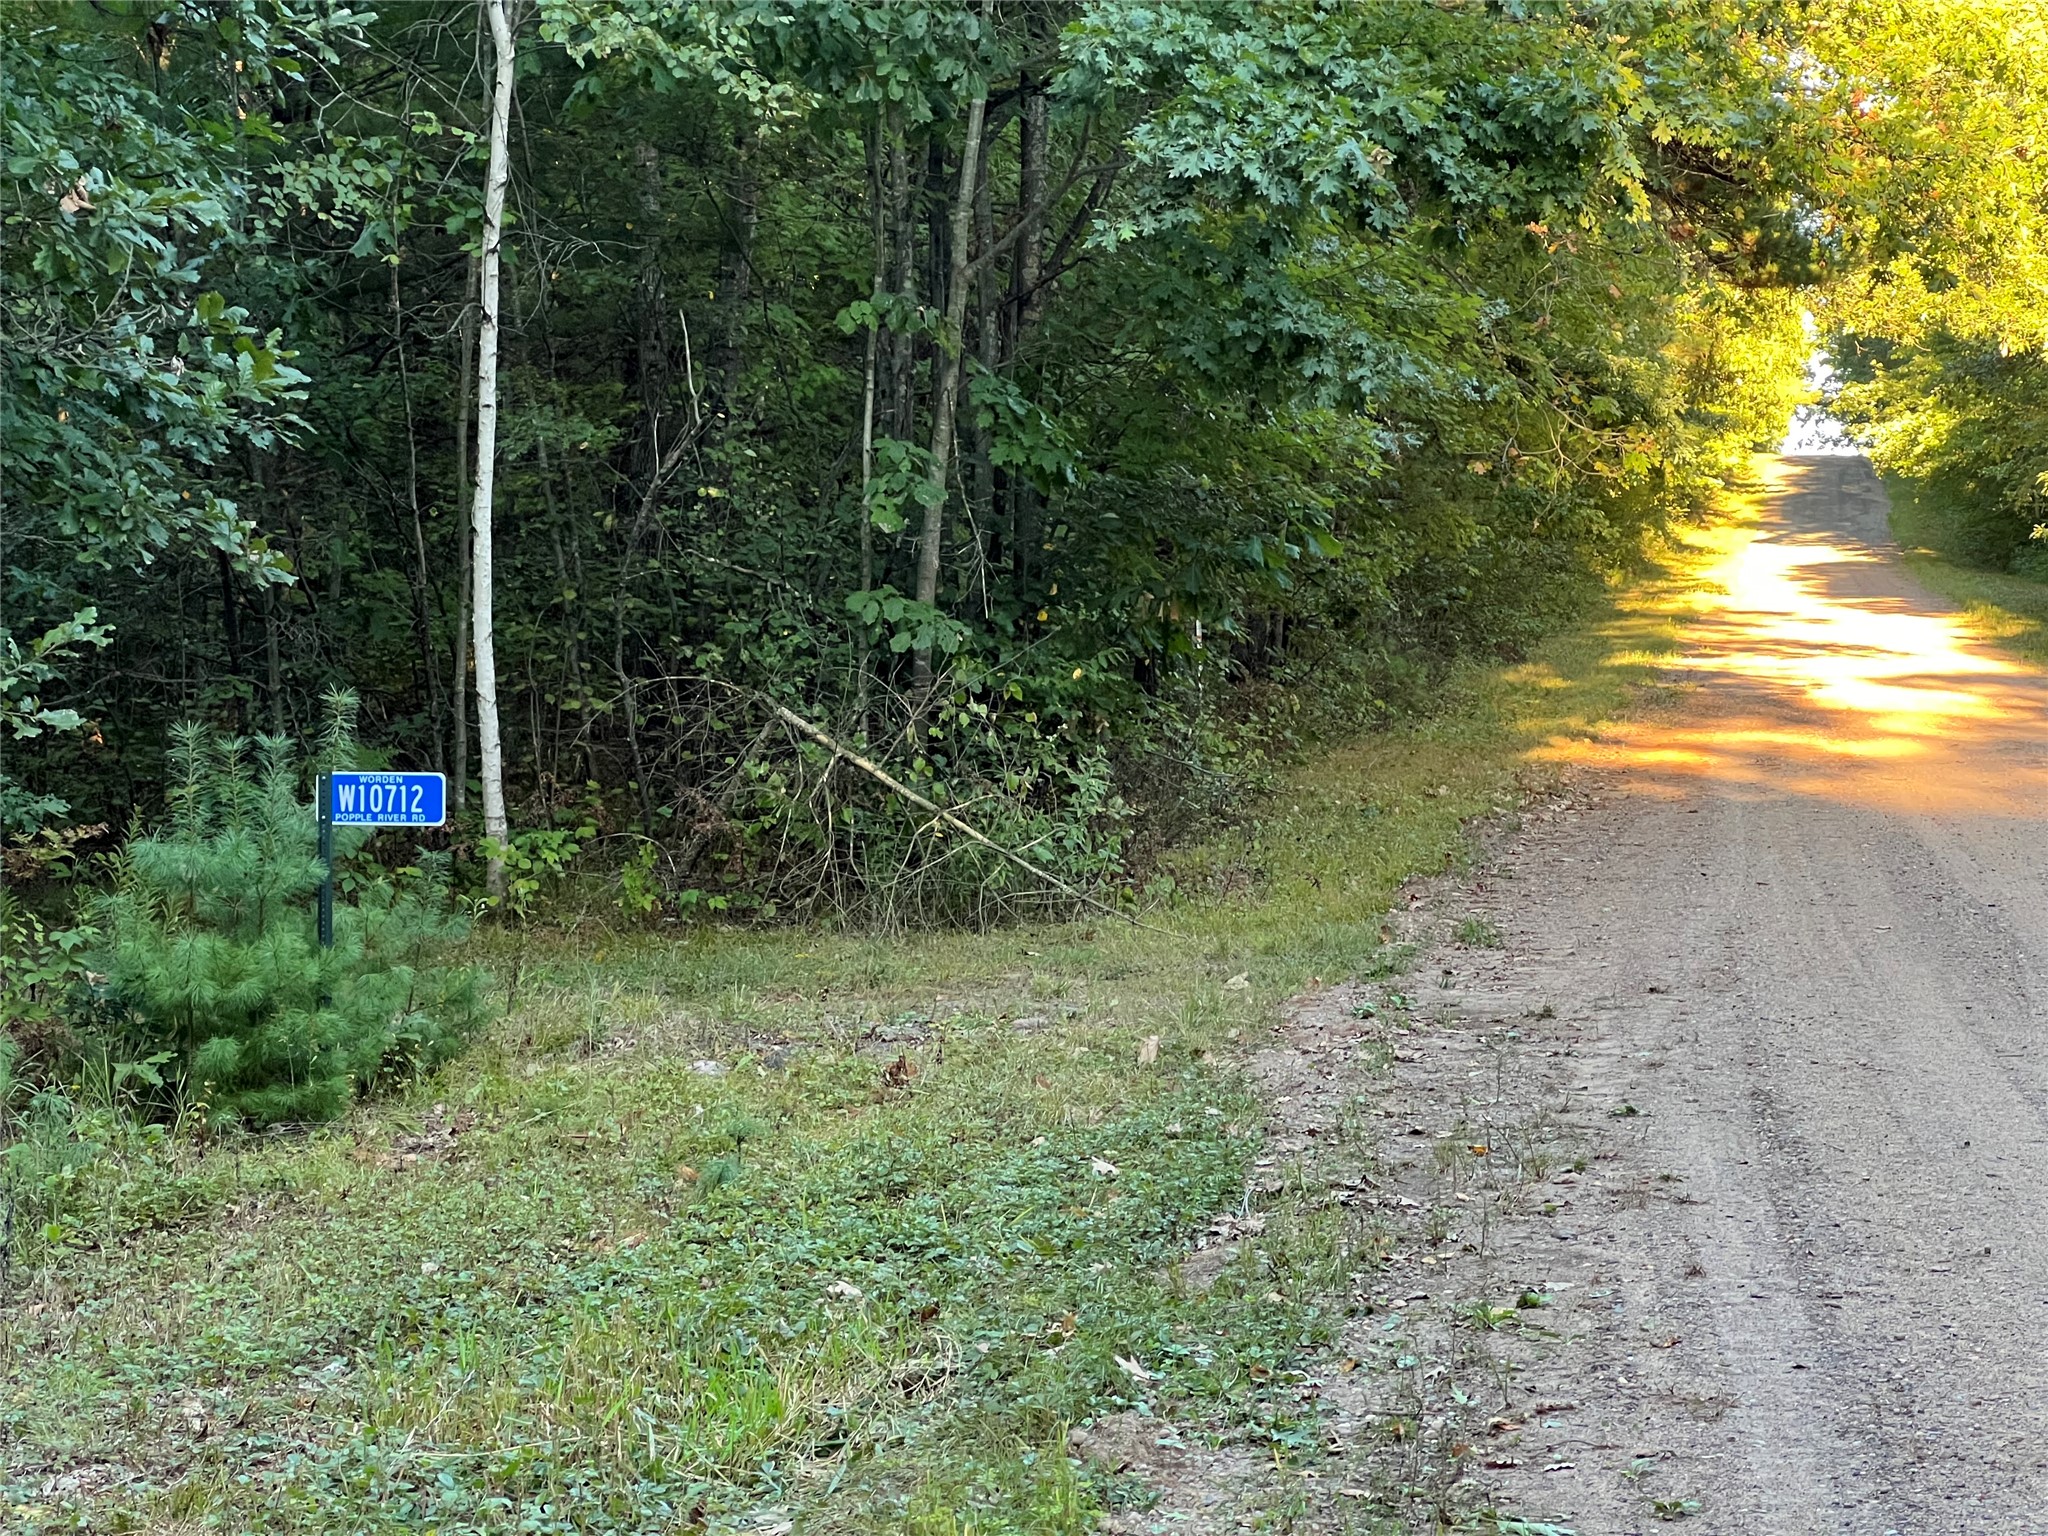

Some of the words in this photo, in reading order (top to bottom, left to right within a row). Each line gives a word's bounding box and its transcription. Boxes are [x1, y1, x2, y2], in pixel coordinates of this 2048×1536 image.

[359, 776, 403, 784] WORDEN
[338, 784, 424, 813] W10712
[335, 813, 372, 822] POPPLE
[377, 813, 407, 822] RIVER
[412, 814, 426, 822] RD
